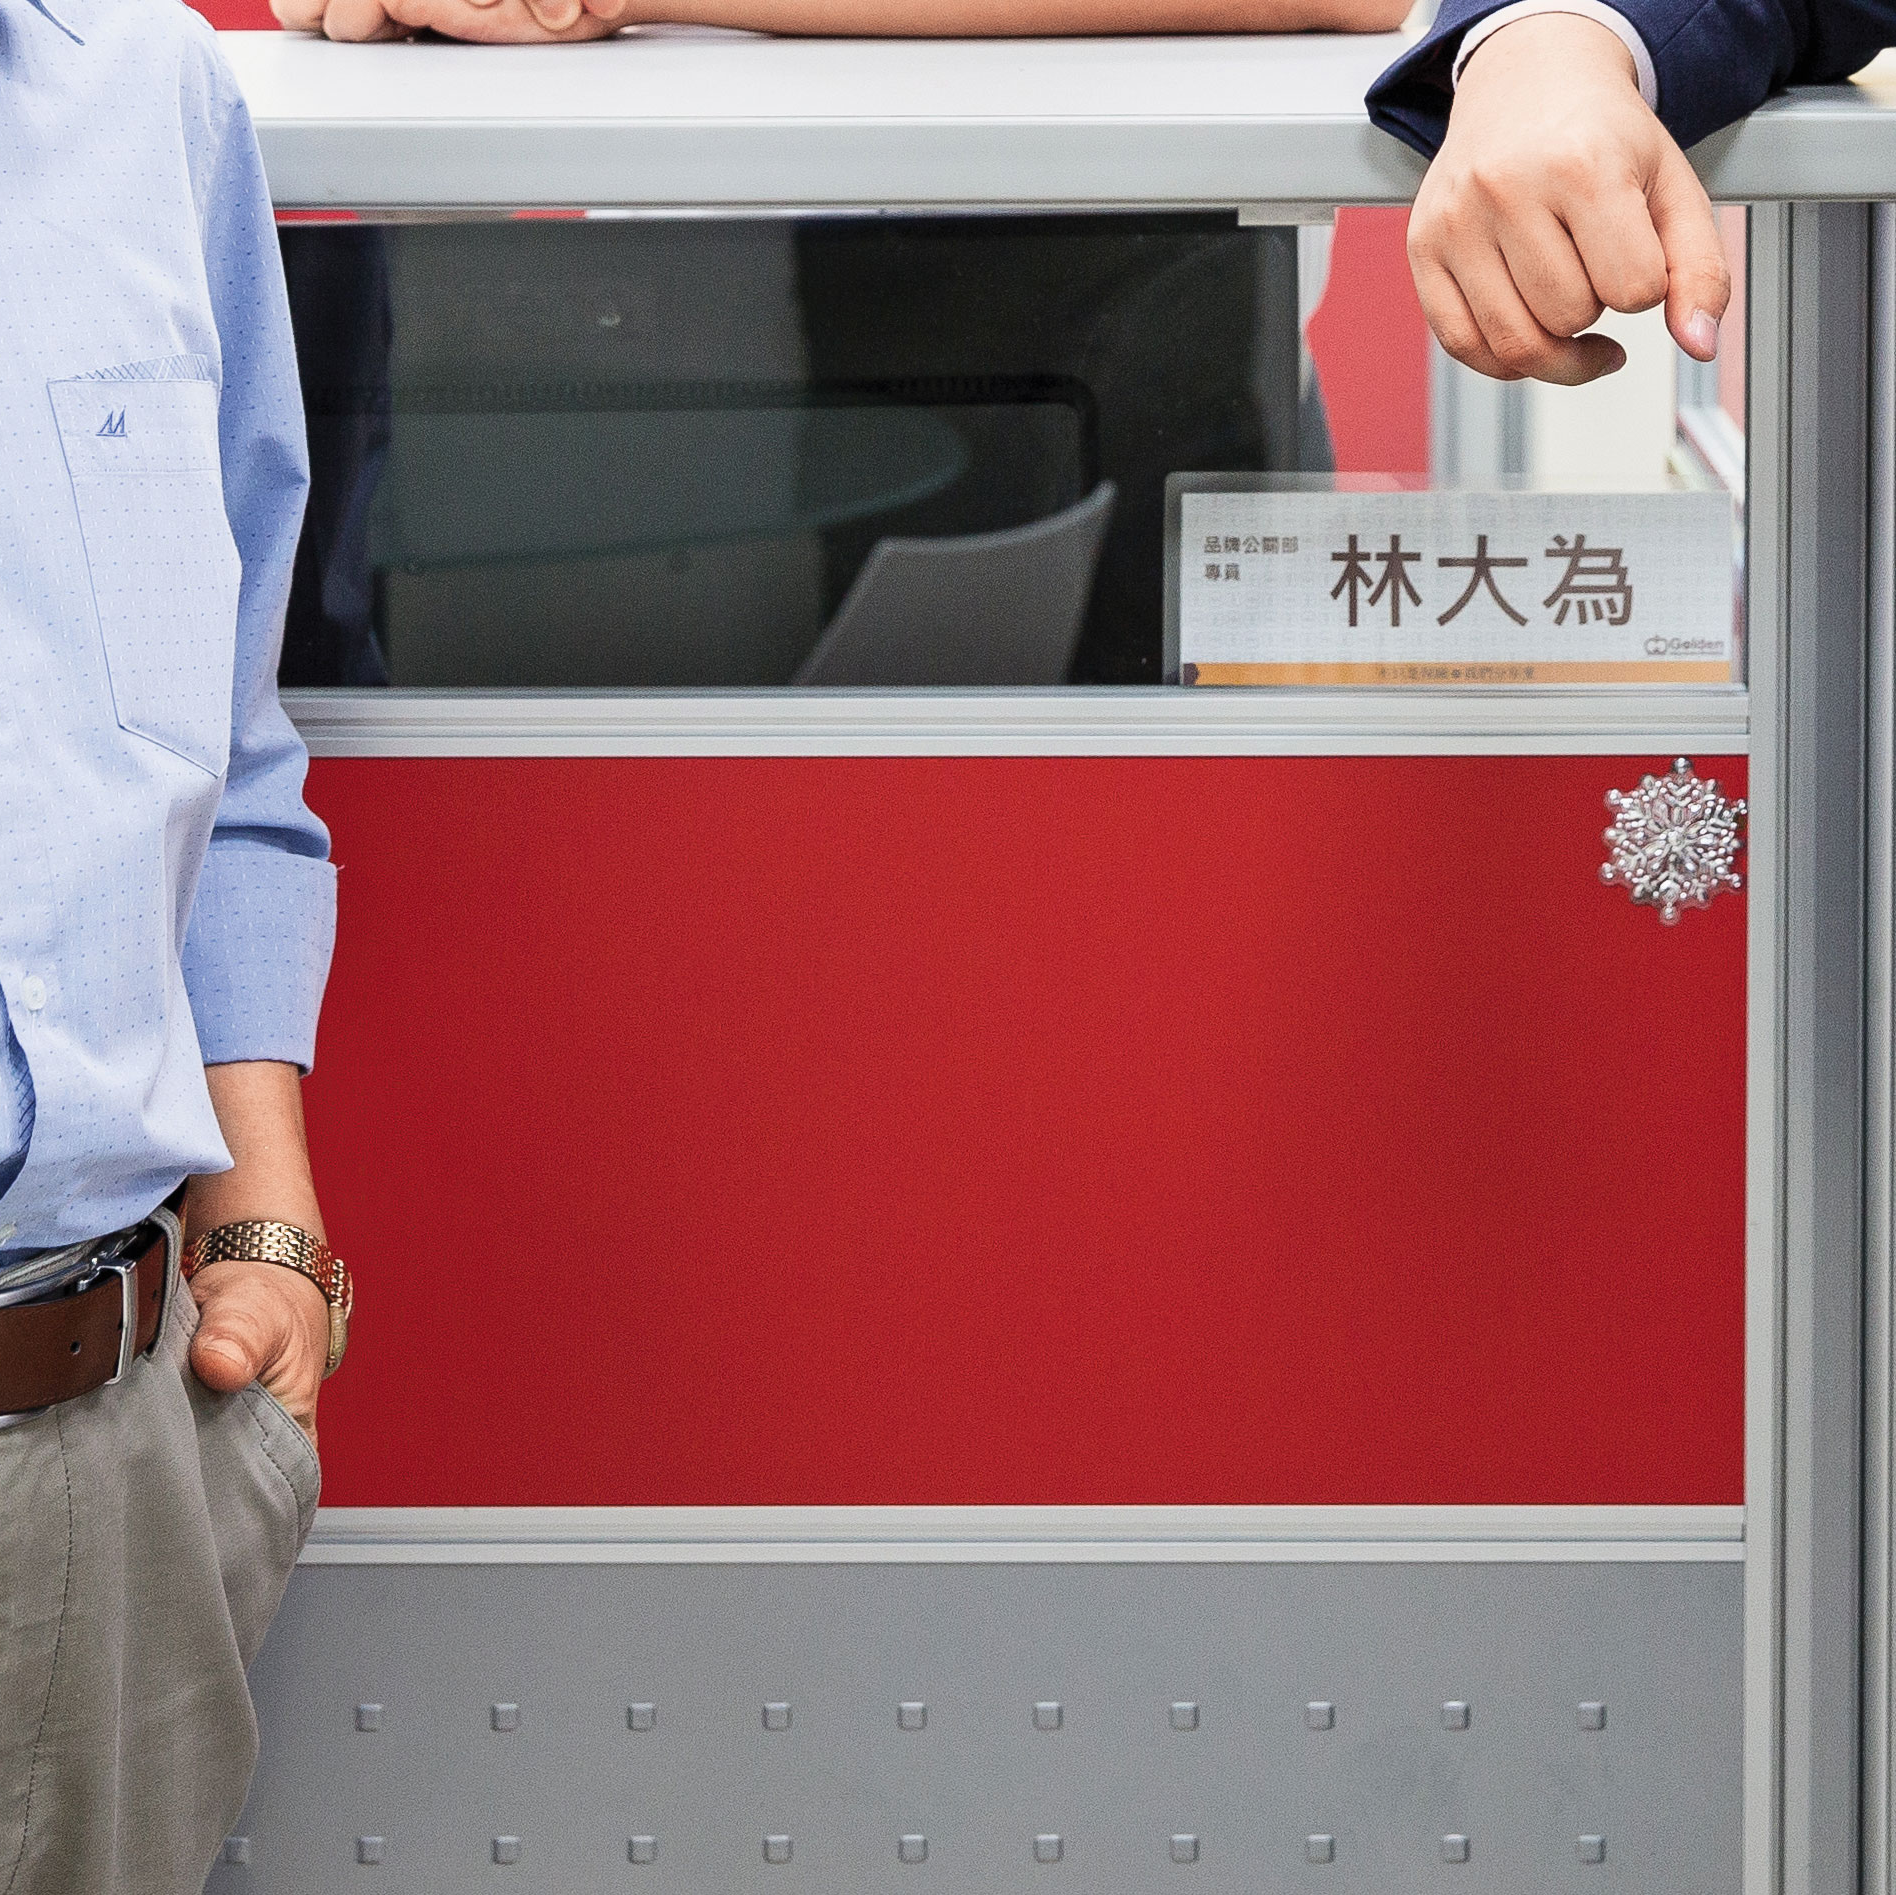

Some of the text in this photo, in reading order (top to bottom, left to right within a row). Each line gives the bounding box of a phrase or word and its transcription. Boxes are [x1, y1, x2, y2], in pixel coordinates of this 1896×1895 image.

[1203, 562, 1241, 582] 專員
[1330, 534, 1634, 628] 林大為
